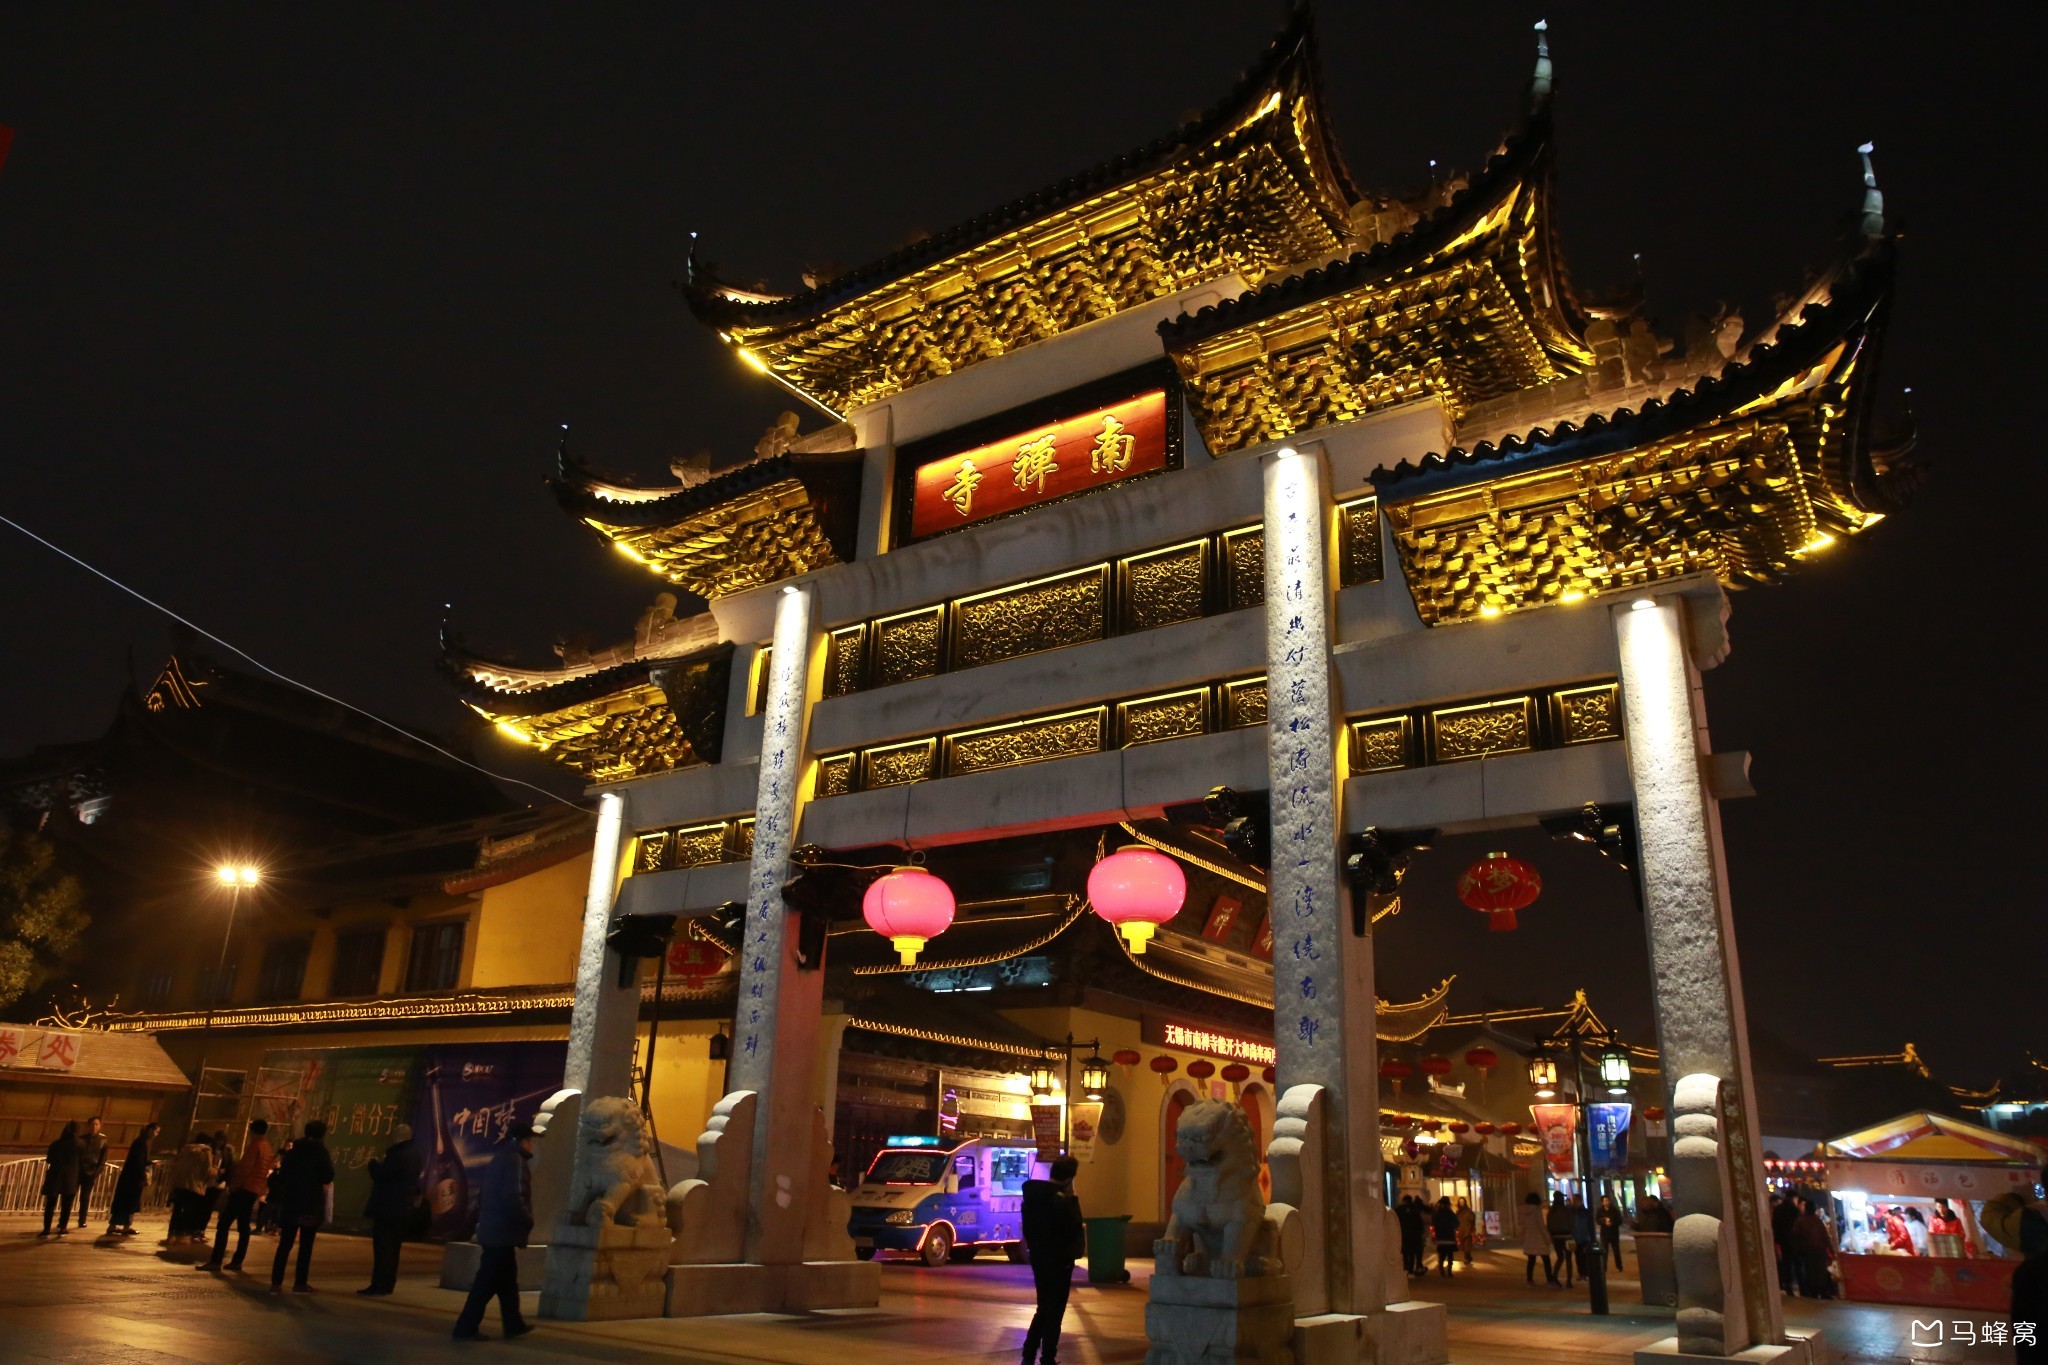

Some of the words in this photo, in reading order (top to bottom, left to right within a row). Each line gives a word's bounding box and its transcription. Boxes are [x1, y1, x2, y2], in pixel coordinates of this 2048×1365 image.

[942, 414, 1136, 516] 南禪寺
[453, 1098, 517, 1145] 中国梦
